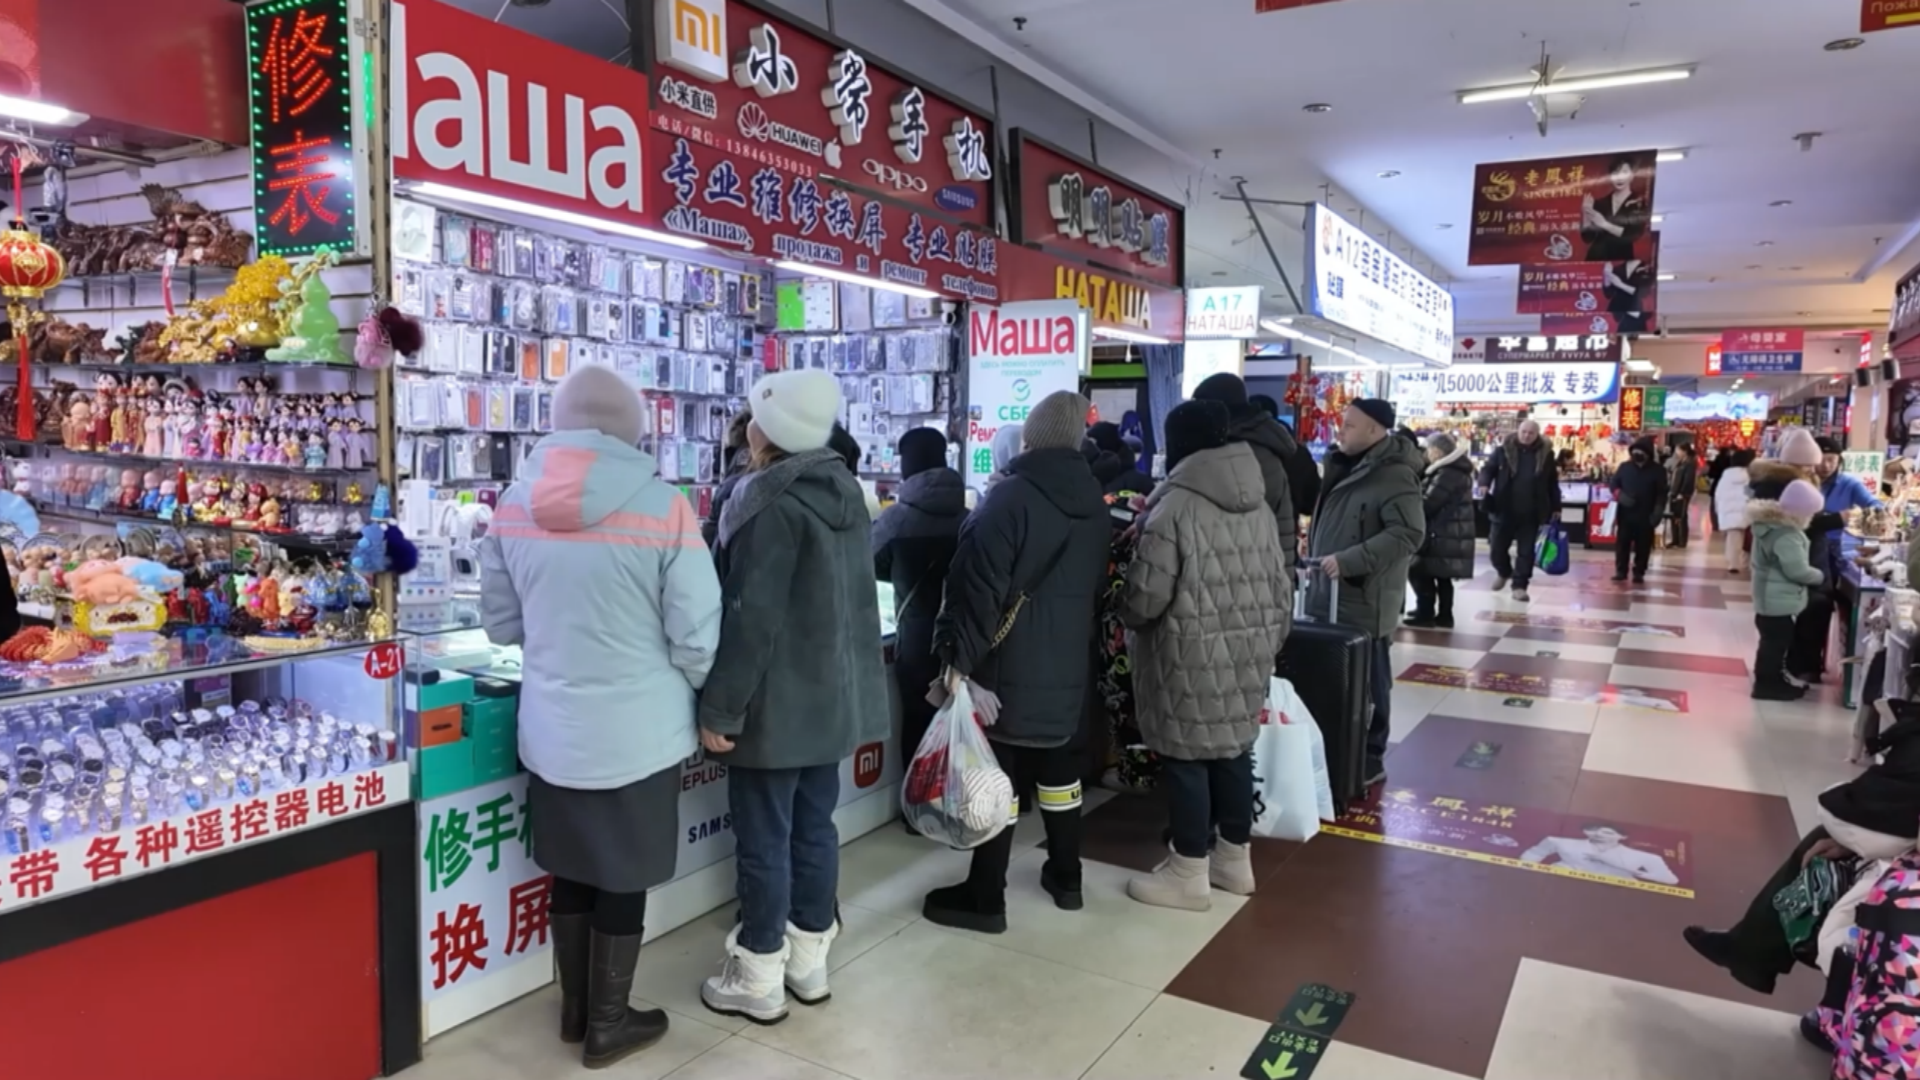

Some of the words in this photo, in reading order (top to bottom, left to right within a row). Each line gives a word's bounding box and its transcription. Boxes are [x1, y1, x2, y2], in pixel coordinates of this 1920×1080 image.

[660, 76, 717, 119] 小米直供
[261, 10, 341, 236] 修表
[771, 122, 823, 156] HUAWEI
[662, 138, 887, 256] 专业维修换屏
[903, 213, 998, 276] 专业贴膜
[1059, 171, 1169, 263] 明明贴膜
[1477, 210, 1503, 225] 岁月
[1507, 222, 1536, 236] 经典
[773, 234, 842, 267] продажа
[856, 254, 869, 273] и
[881, 260, 927, 286] ремонт
[942, 274, 998, 300] телефонов
[1056, 265, 1152, 331] НАТАША
[1202, 294, 1243, 312] A17
[971, 309, 1075, 357] Маша
[1187, 314, 1255, 332] НАТАША
[1564, 372, 1600, 395] 专卖
[1622, 390, 1641, 430] 修表
[973, 448, 992, 473] 维
[369, 647, 402, 676] A-21
[0, 849, 59, 899] 带
[84, 770, 386, 881] 各种遥控器电池
[430, 874, 552, 989] 换屏
